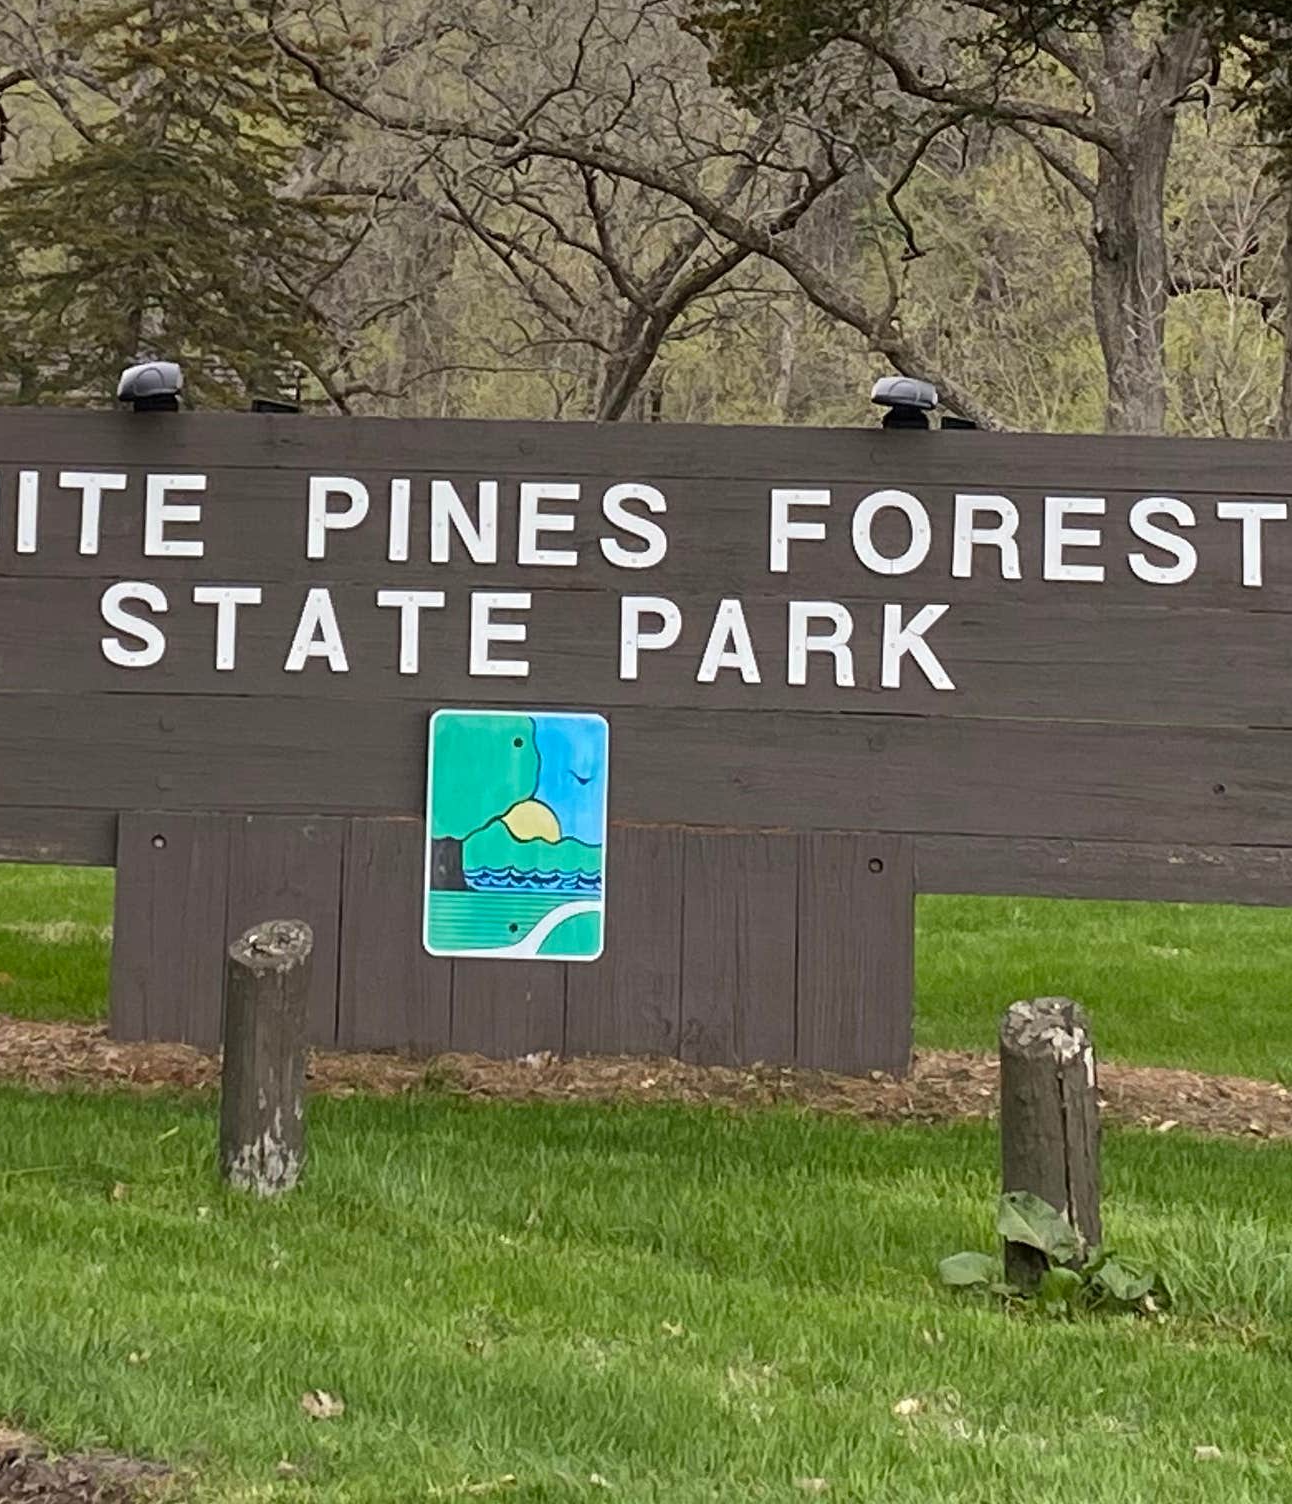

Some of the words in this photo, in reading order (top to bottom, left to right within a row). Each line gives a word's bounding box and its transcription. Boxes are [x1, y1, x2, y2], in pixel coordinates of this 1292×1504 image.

[306, 476, 668, 570] PINES
[769, 488, 1289, 588] FOREST
[100, 581, 533, 678] STATE
[618, 595, 957, 691] PARK
